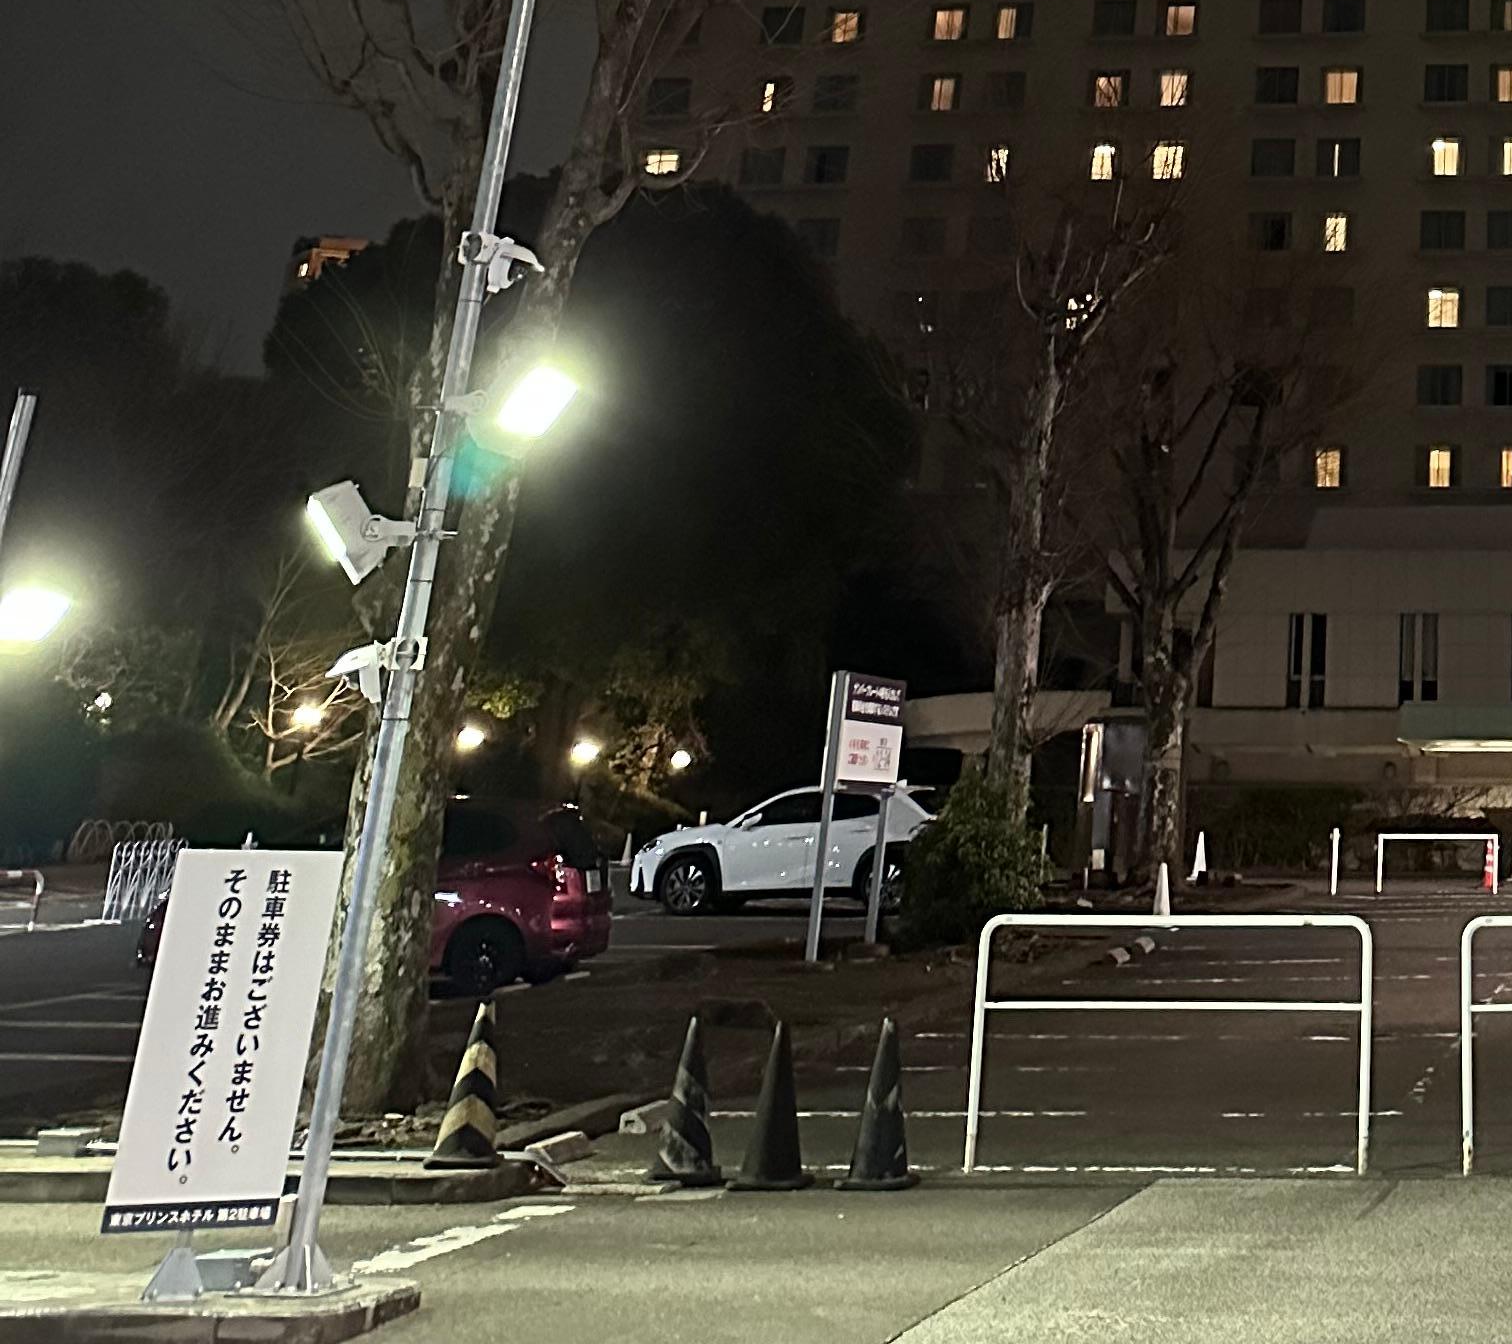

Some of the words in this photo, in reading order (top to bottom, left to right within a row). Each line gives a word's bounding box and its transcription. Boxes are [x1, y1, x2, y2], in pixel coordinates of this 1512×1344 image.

[168, 869, 247, 1185] そのままお進みください。
[218, 869, 292, 1154] 駐車券はございません。
